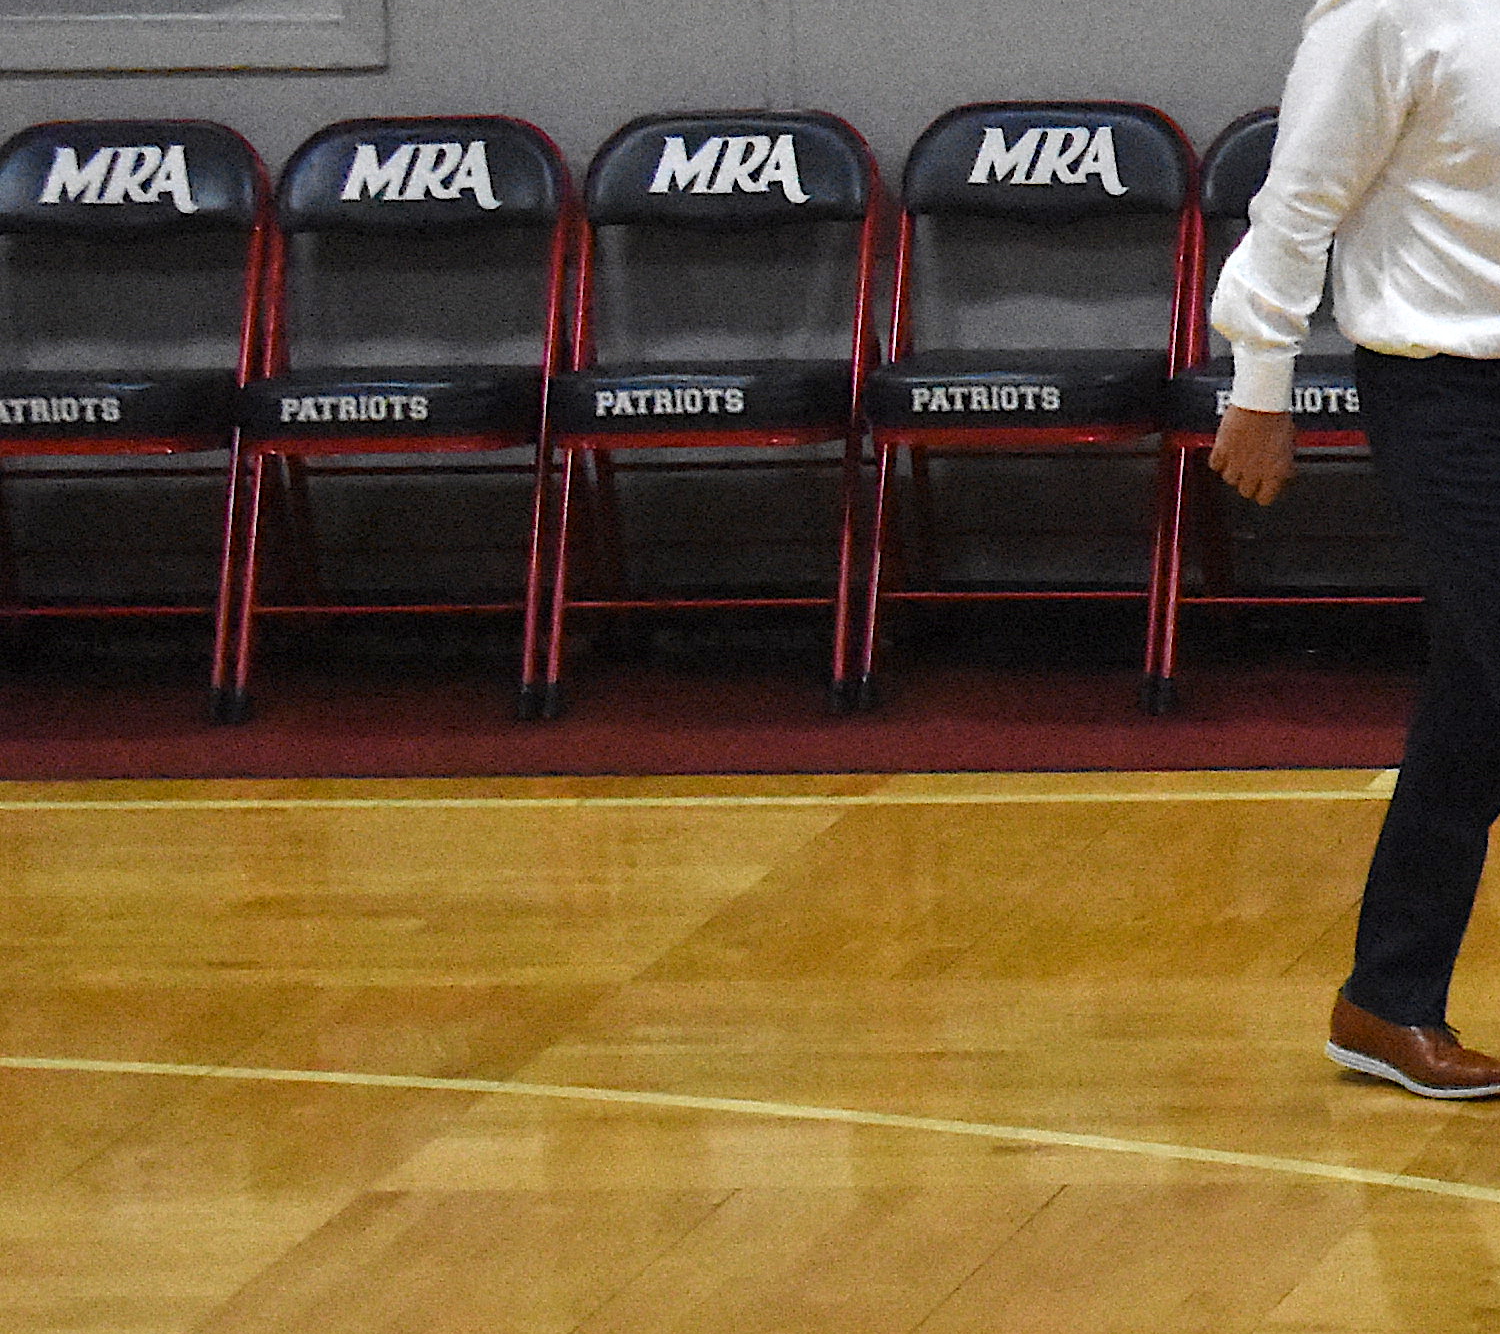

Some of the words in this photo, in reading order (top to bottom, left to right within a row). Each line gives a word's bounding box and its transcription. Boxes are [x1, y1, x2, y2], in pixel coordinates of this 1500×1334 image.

[38, 144, 199, 214] MRA
[340, 140, 502, 210] MRA
[649, 134, 811, 203] MRA
[967, 126, 1128, 196] MRA
[279, 395, 429, 423] PATRIOTS
[595, 387, 745, 417] PATRIOTS
[912, 385, 1062, 414] PATRIOTS
